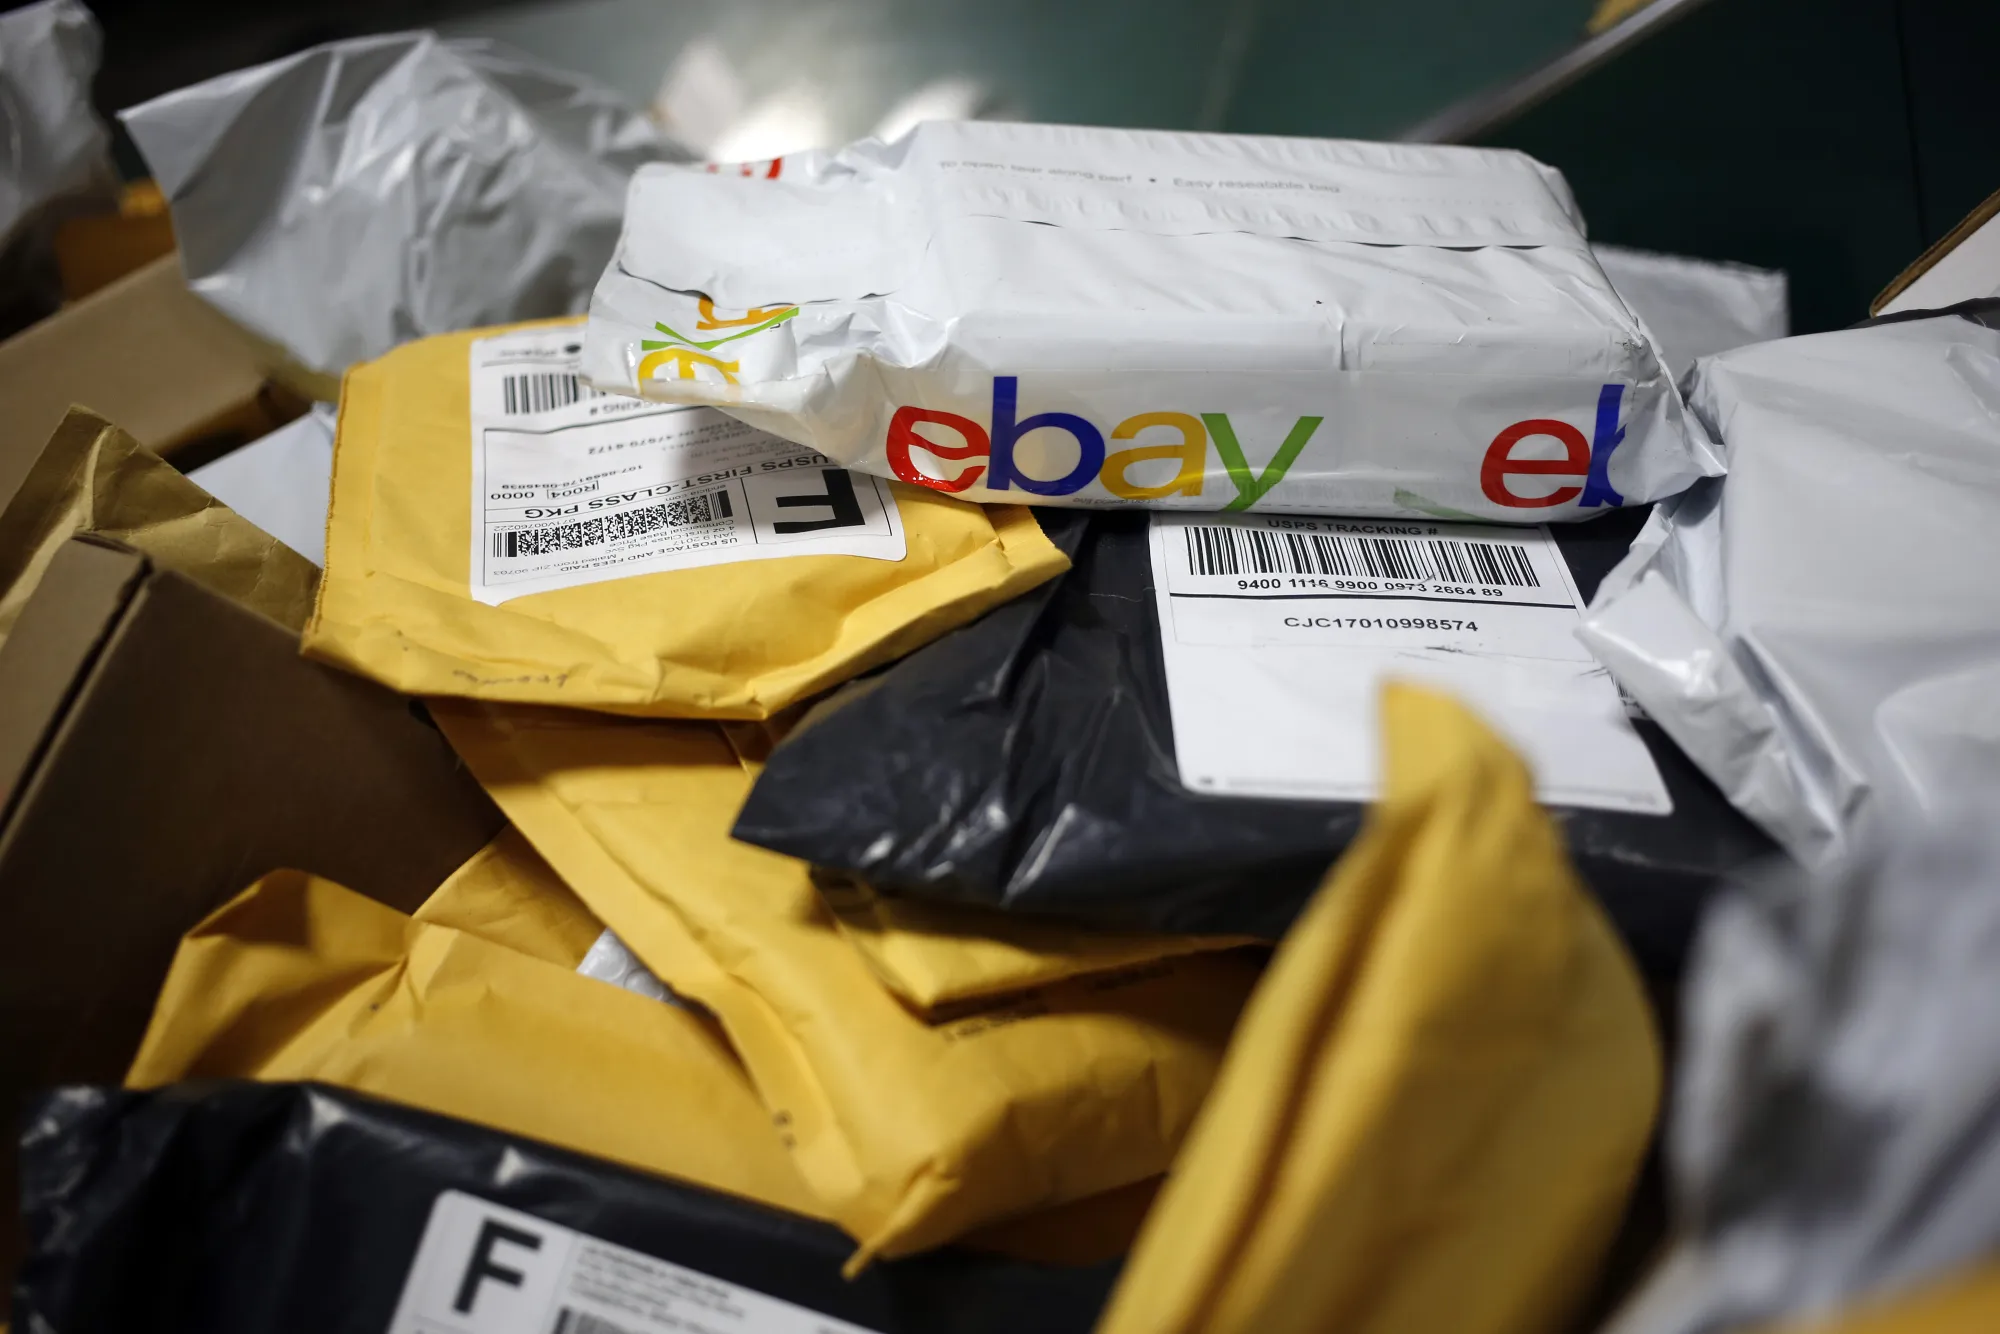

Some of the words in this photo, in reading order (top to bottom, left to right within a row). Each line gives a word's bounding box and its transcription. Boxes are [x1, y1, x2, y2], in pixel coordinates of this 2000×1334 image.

[1172, 177, 1213, 189] Easy
[1218, 179, 1305, 190] resealable
[1308, 182, 1341, 194] bag
[885, 375, 1325, 512] ebay
[760, 454, 829, 472] USPS
[587, 465, 753, 510] FIRST-CLASS
[490, 491, 535, 501] 0000
[773, 468, 867, 534] F
[524, 504, 580, 519] PKG
[670, 519, 735, 534] Commercial
[1266, 519, 1319, 532] USPS
[1324, 522, 1422, 536] TRACKING
[1421, 526, 1439, 536] #
[640, 531, 668, 541] Base
[720, 529, 736, 539] JAN
[609, 538, 638, 548] Price
[627, 541, 649, 550] Pkg
[672, 536, 700, 547] 2017
[720, 536, 739, 545] US
[657, 540, 719, 555] POSTAGE
[581, 553, 618, 565] Mailed
[627, 550, 655, 561] AND
[531, 563, 552, 572] ZIP
[553, 559, 579, 568] from
[559, 563, 590, 573] PAID
[592, 557, 625, 568] FEES
[1237, 577, 1282, 590] 9400
[1288, 578, 1328, 589] 1116
[1334, 579, 1378, 591] 9900
[1384, 581, 1428, 593] 0973
[1433, 584, 1477, 597] 2664
[1481, 587, 1504, 598] 89
[1283, 616, 1479, 632] CJC17010998574
[451, 1215, 544, 1317] F
